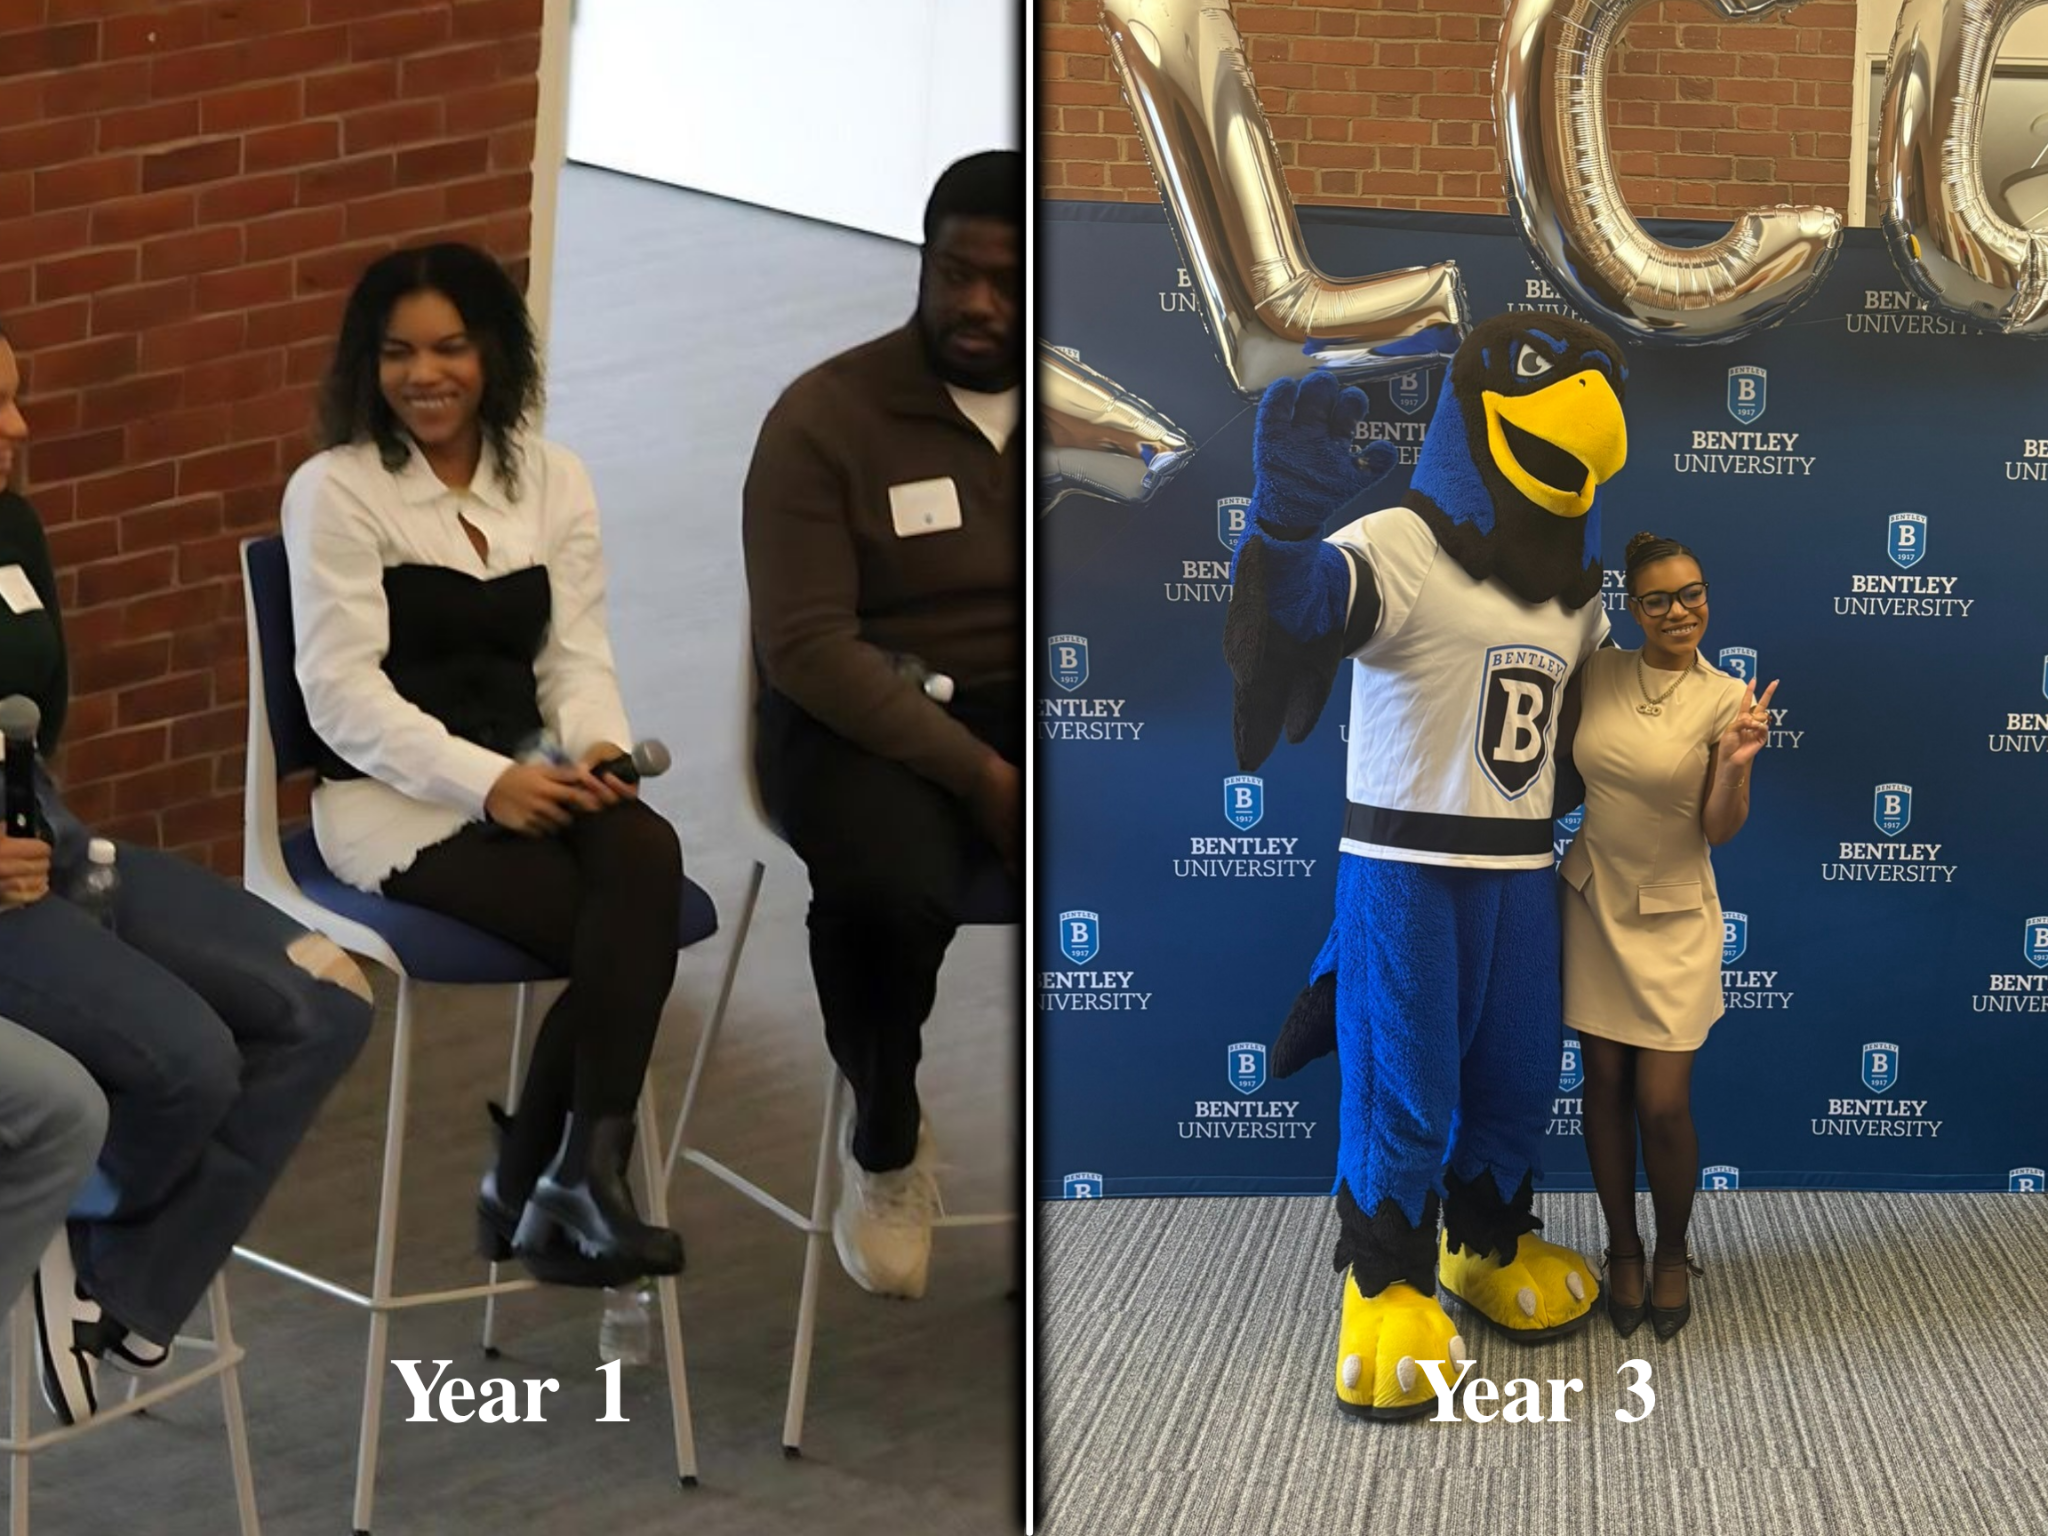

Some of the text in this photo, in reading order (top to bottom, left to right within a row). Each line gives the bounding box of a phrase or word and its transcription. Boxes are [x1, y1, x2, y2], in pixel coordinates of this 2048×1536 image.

[1846, 313, 1983, 335] UNIVERSI
[1729, 366, 1766, 376] BENTLEY
[1738, 378, 1756, 401] B
[1400, 399, 1418, 407] 1917
[1737, 408, 1756, 416] 1917
[1692, 430, 1799, 451] BENTLEY
[1673, 453, 1816, 475] UNIVERSITY
[1219, 498, 1251, 506] BENTLE
[1228, 509, 1246, 531] B
[1890, 514, 1926, 522] BENTLEY
[1898, 524, 1916, 546] B
[1897, 553, 1916, 561] 1917
[1851, 574, 1958, 594] BENTLEY
[1833, 596, 1974, 617] UNIVERSITY
[1049, 636, 1086, 644] BENTLEY
[1058, 646, 1078, 669] B
[1492, 652, 1563, 678] BENTLEY
[1060, 676, 1079, 684] 1917
[1493, 677, 1544, 763] B
[1225, 777, 1262, 785] BENTLEY
[1876, 784, 1911, 792] BENTLEY
[1234, 787, 1253, 809] B
[1883, 794, 1901, 815] B
[1235, 815, 1253, 823] 1917
[1190, 837, 1298, 855] BENTLEY
[1838, 842, 1942, 861] BENTLEY
[1172, 859, 1316, 877] UNIVERSITY
[1821, 863, 1958, 882] UNIVERSITY
[1061, 911, 1097, 919] BENTLEY
[1070, 921, 1089, 943] B
[1723, 923, 1738, 943] B
[2034, 927, 2048, 948] B
[1723, 949, 1737, 957] 917
[1720, 970, 1778, 988] TLEY
[1989, 974, 2048, 991] BENT
[1038, 992, 1152, 1011] IVERSITY
[1229, 1043, 1265, 1051] BENTLEY
[1864, 1043, 1898, 1051] BENTLEY
[1238, 1053, 1256, 1074] B
[1561, 1051, 1576, 1071] B
[1871, 1053, 1888, 1073] B
[1871, 1079, 1888, 1087] 1917
[1194, 1101, 1299, 1118] BENTLEY
[1828, 1098, 1928, 1117] BENTLEY
[1177, 1121, 1317, 1139] UNIVERSITY
[1811, 1118, 1943, 1137] UNIVERSITY
